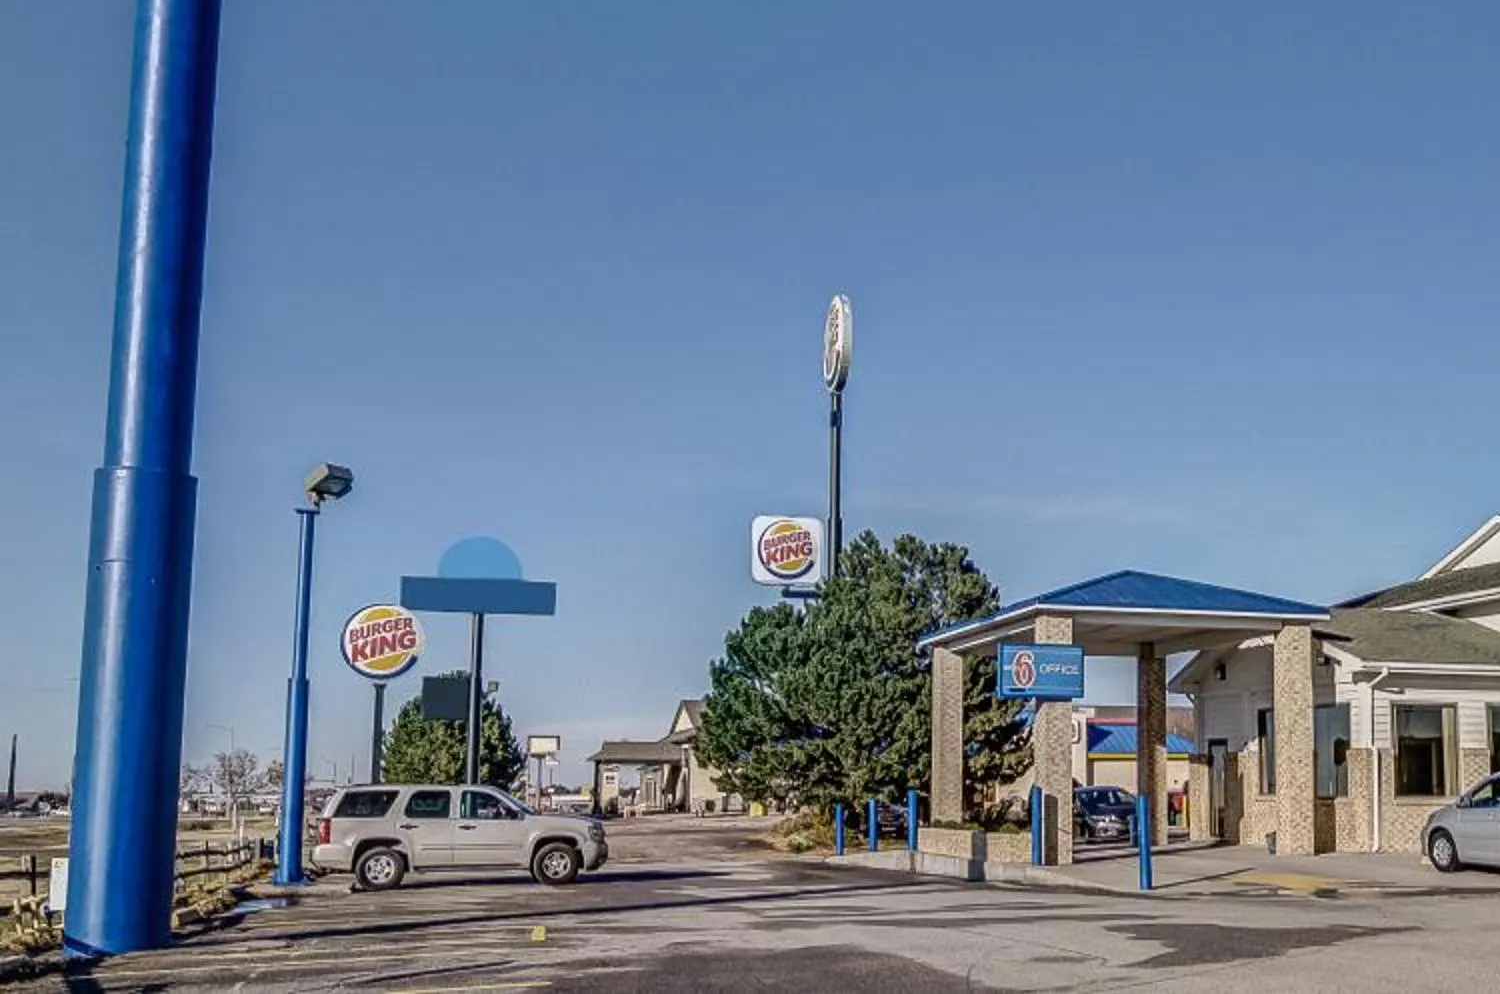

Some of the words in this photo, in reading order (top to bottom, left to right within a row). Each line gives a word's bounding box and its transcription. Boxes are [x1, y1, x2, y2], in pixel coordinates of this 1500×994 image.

[764, 531, 811, 551] BURGER
[766, 542, 813, 567] KING
[350, 617, 413, 644] BURGER
[351, 630, 417, 663] KING
